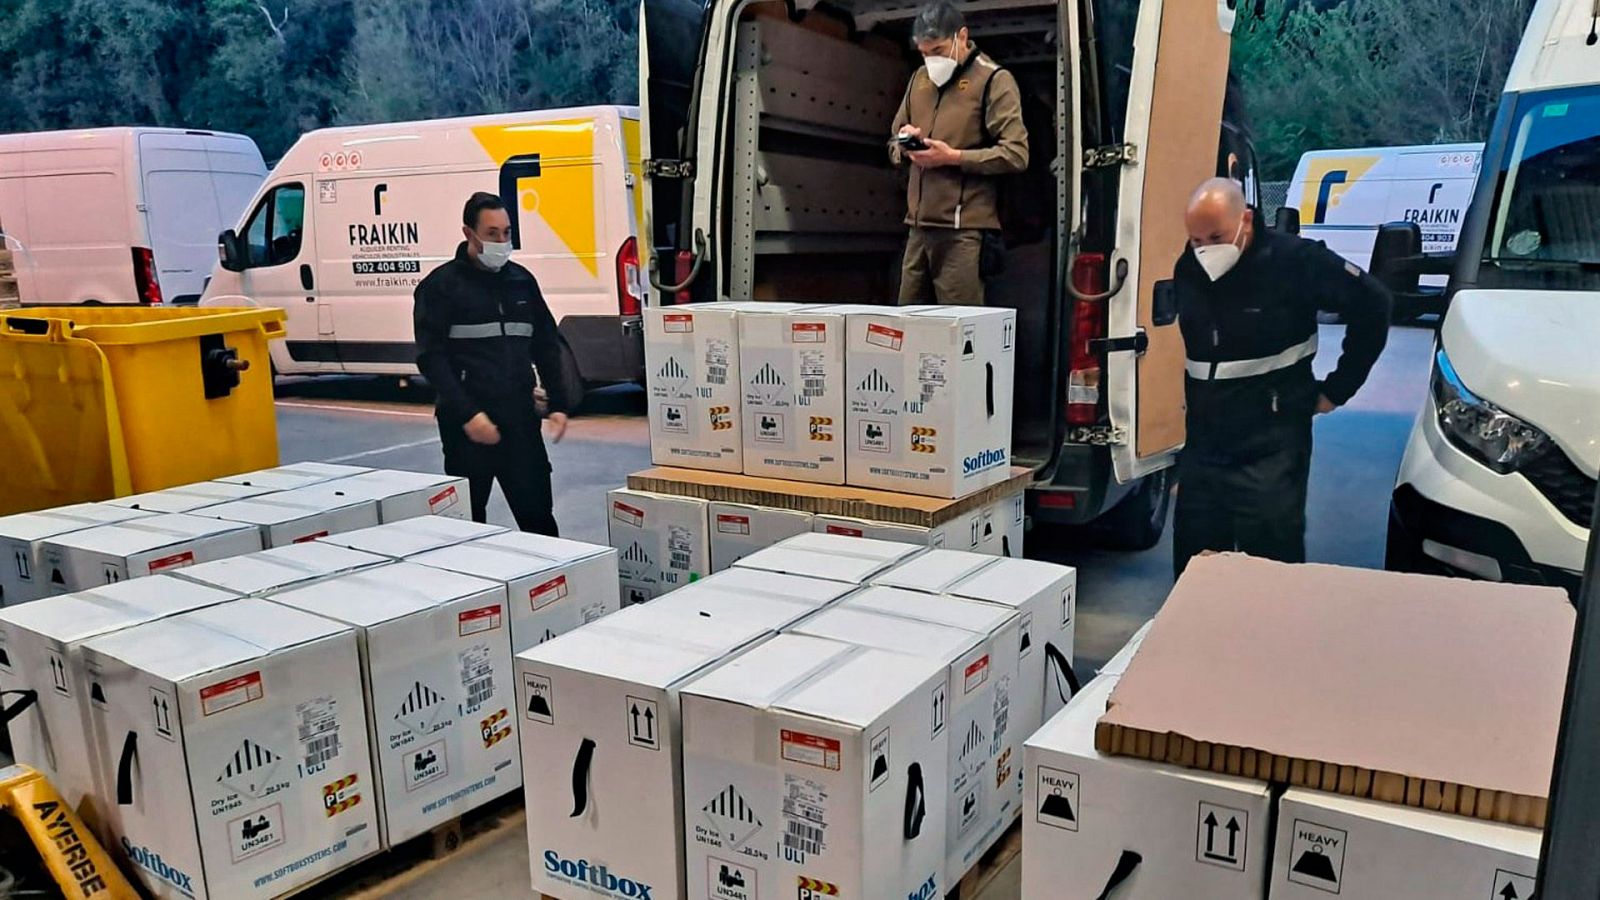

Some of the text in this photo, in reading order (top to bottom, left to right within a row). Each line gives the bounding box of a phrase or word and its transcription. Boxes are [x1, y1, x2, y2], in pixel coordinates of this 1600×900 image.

[1404, 209, 1460, 224] FRAIKIN
[349, 222, 419, 246] FRAIKIN
[356, 261, 417, 273] 902 404 903
[963, 447, 1006, 474] Softbox
[526, 680, 549, 692] HEAVY
[1041, 776, 1075, 791] HEAVY
[211, 799, 225, 807] Dry
[241, 833, 274, 851] UN3481
[1298, 829, 1340, 849] HEAVY
[34, 800, 107, 898] AYERBE
[121, 836, 193, 892] Softbox
[544, 850, 653, 900] Softbox
